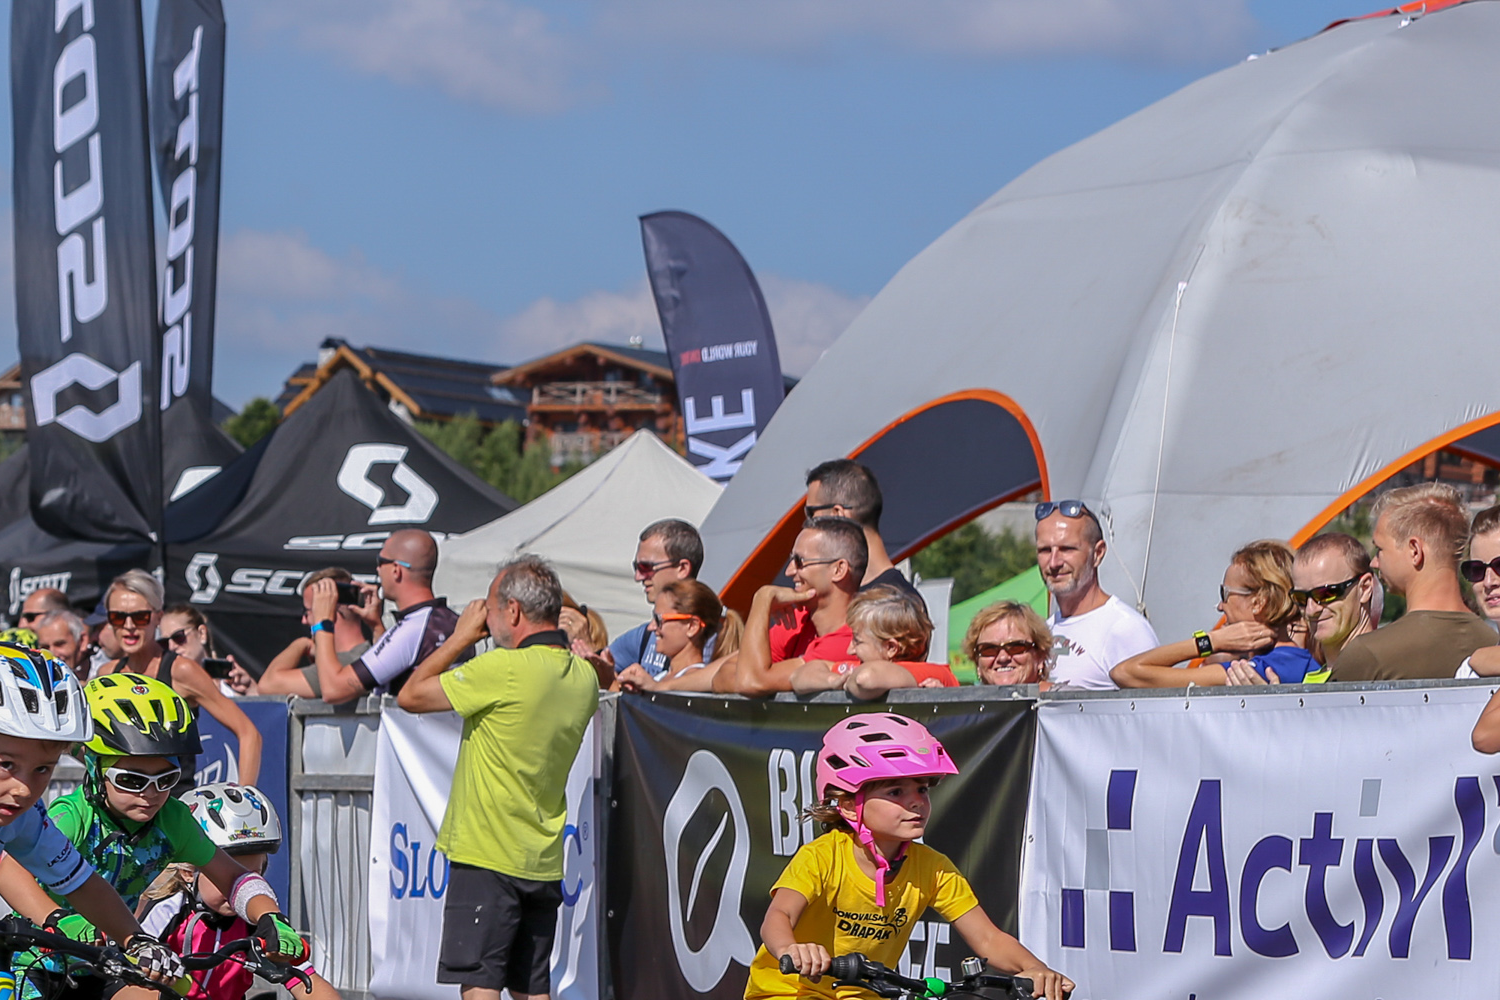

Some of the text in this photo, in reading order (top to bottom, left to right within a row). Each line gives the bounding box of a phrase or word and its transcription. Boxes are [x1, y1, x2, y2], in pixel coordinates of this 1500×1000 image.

[55, 0, 108, 344] SCO
[160, 25, 204, 411] SCOTT
[684, 388, 758, 480] KE
[389, 821, 451, 900] SLO
[836, 919, 893, 941] DRAPÁK
